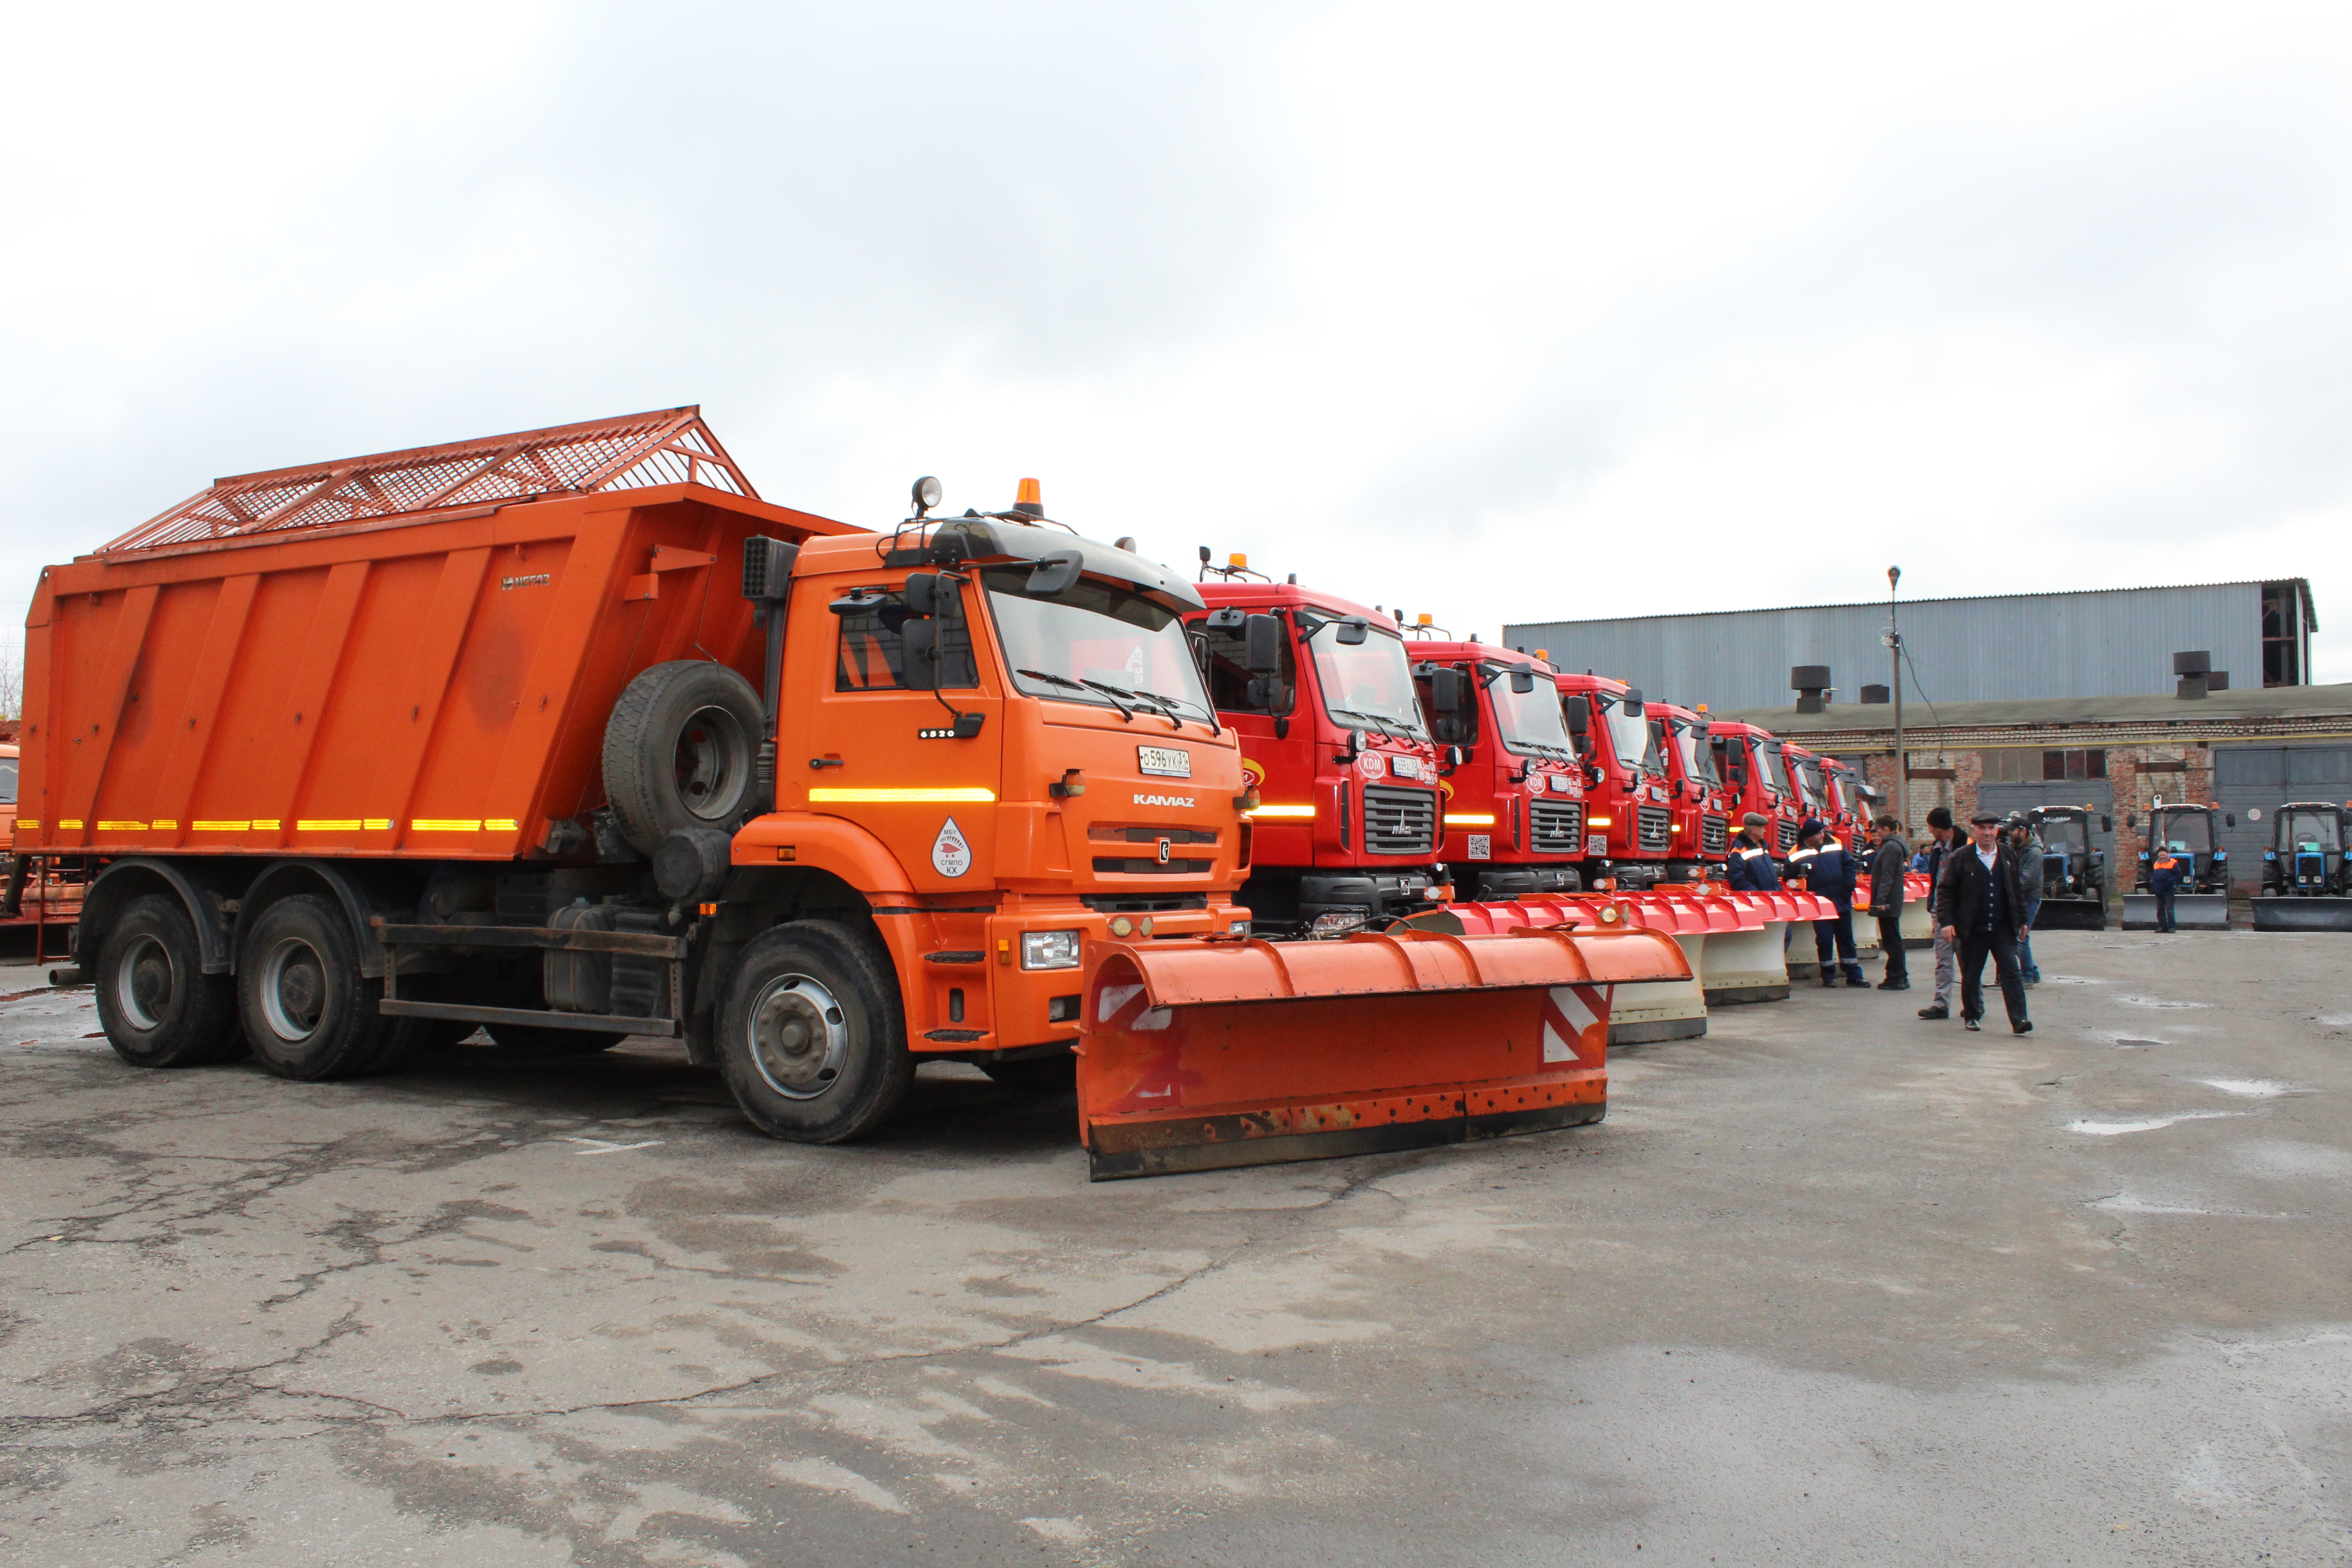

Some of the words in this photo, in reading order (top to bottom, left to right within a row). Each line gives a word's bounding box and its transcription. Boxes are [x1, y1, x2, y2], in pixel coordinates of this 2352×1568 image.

[515, 573, 550, 588] NEFAZ
[920, 730, 955, 738] 6520
[1363, 757, 1381, 771] KDM
[1529, 777, 1543, 787] KDM
[1134, 794, 1194, 807] KAMAZ
